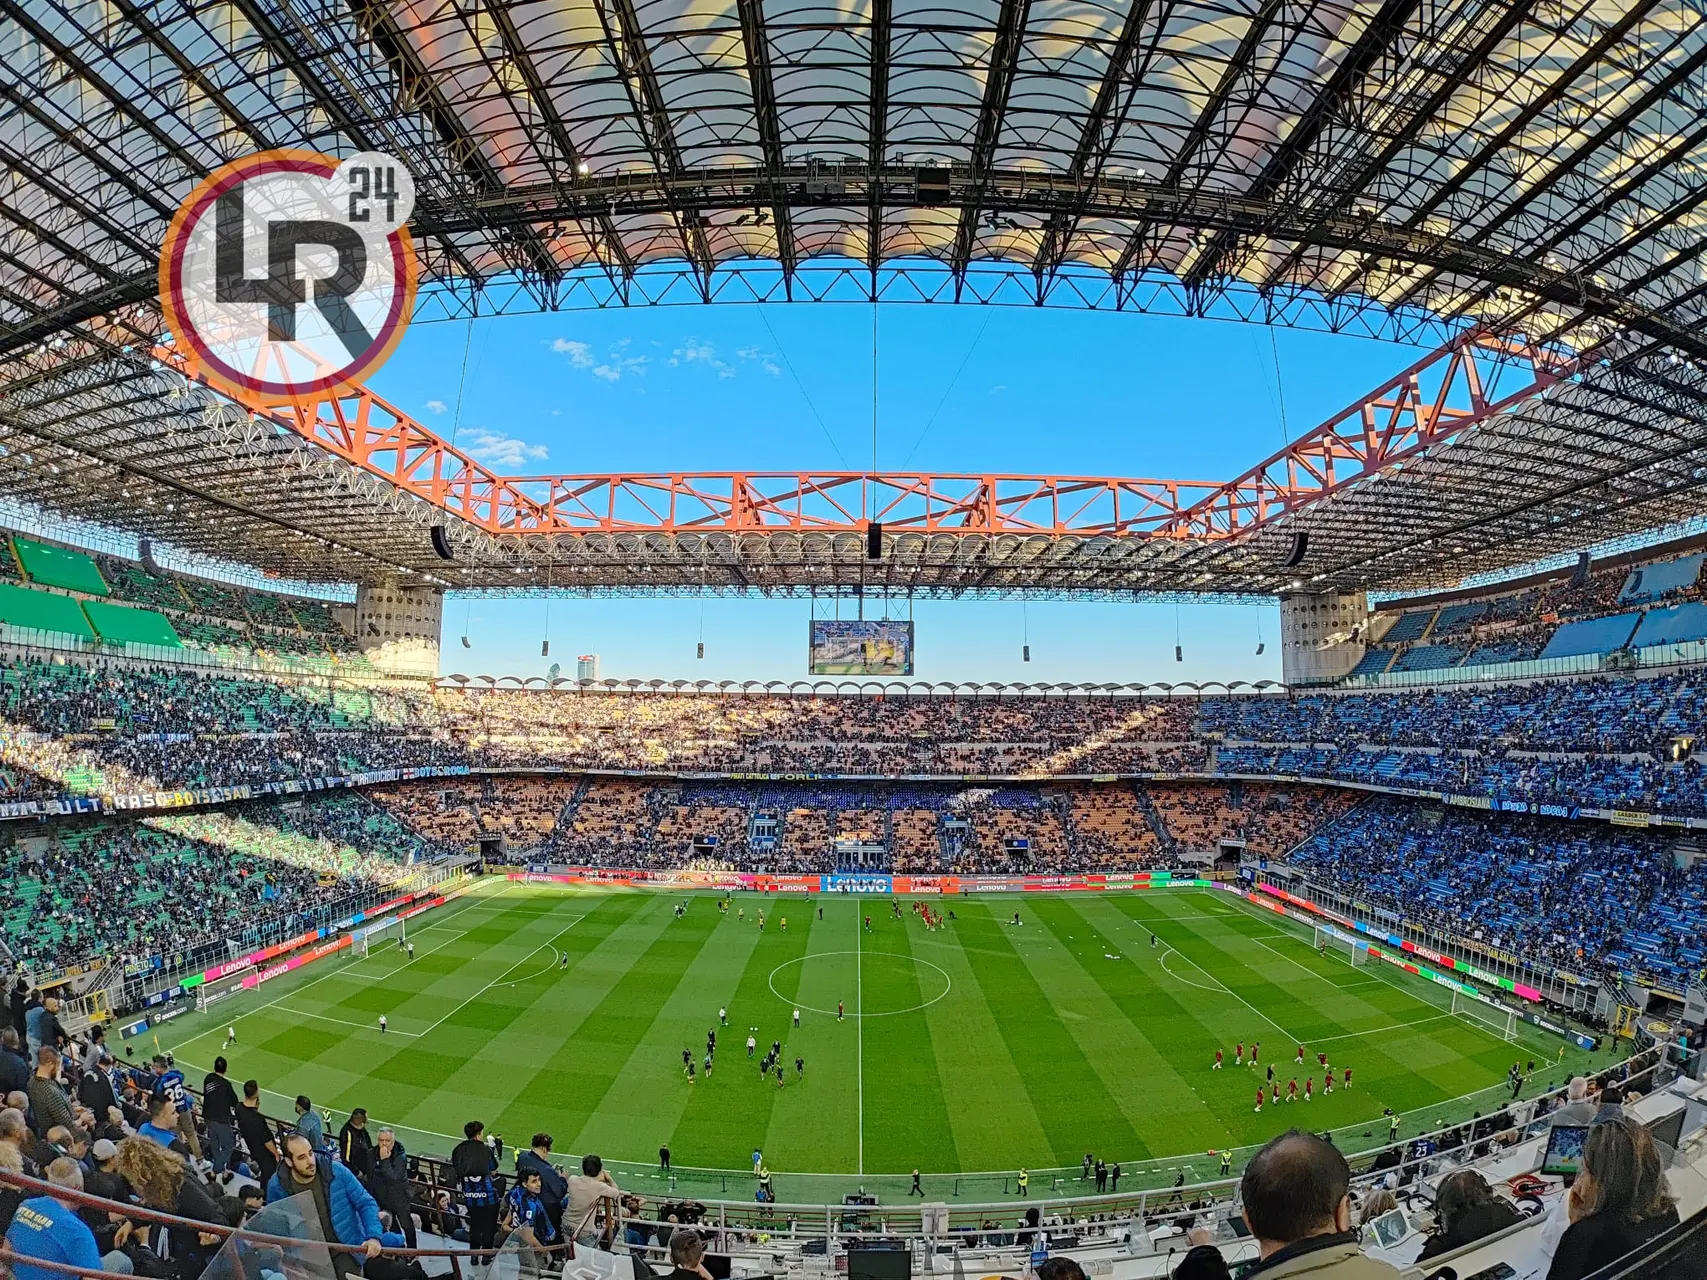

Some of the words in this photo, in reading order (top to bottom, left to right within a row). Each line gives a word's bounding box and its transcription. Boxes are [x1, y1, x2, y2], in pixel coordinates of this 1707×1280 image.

[174, 790, 210, 806] BOYS
[224, 784, 250, 801] SAN
[827, 876, 886, 893] Lenovo
[1105, 873, 1134, 881] Lenovo
[778, 884, 808, 892] Lenovo
[1256, 896, 1275, 910] Lenovo
[1293, 911, 1314, 925] Lenovo
[279, 934, 306, 950] Lenovo
[315, 939, 341, 955] Lenovo
[1414, 944, 1441, 963] Lenovo
[124, 960, 149, 974] PINETO
[220, 957, 251, 975] Lenovo
[259, 964, 289, 982] Lenovo
[1433, 972, 1462, 992] Lenovo
[1469, 965, 1499, 985] Lenovo
[1415, 1146, 1428, 1158] 23
